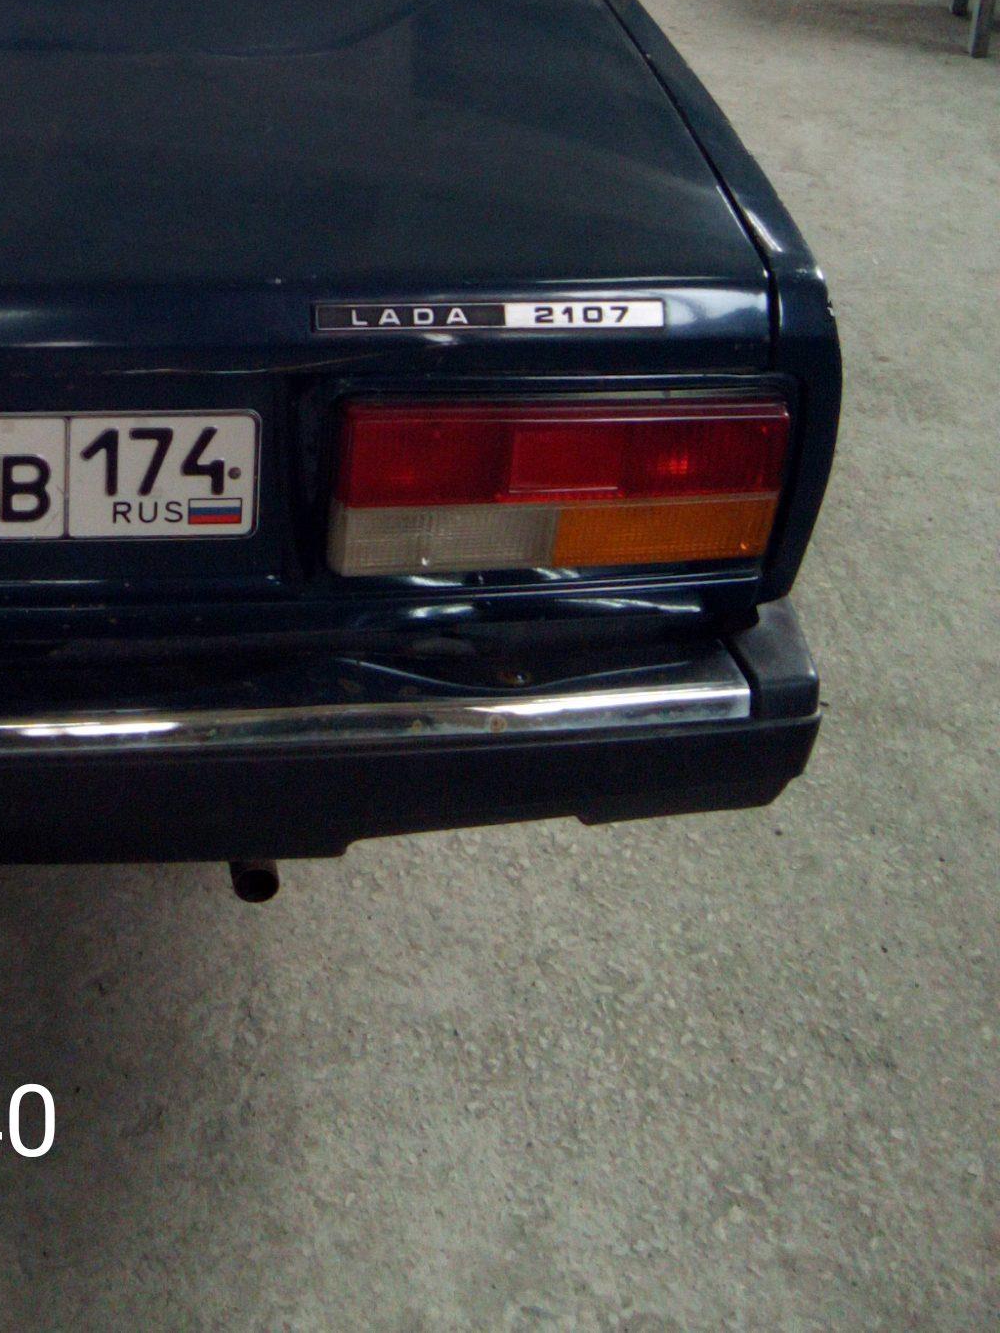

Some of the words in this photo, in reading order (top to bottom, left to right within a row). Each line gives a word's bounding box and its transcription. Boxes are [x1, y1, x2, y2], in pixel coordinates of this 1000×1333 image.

[351, 307, 469, 327] LADA
[534, 306, 630, 324] 2107
[80, 426, 226, 496] 174
[111, 500, 184, 524] RUS
